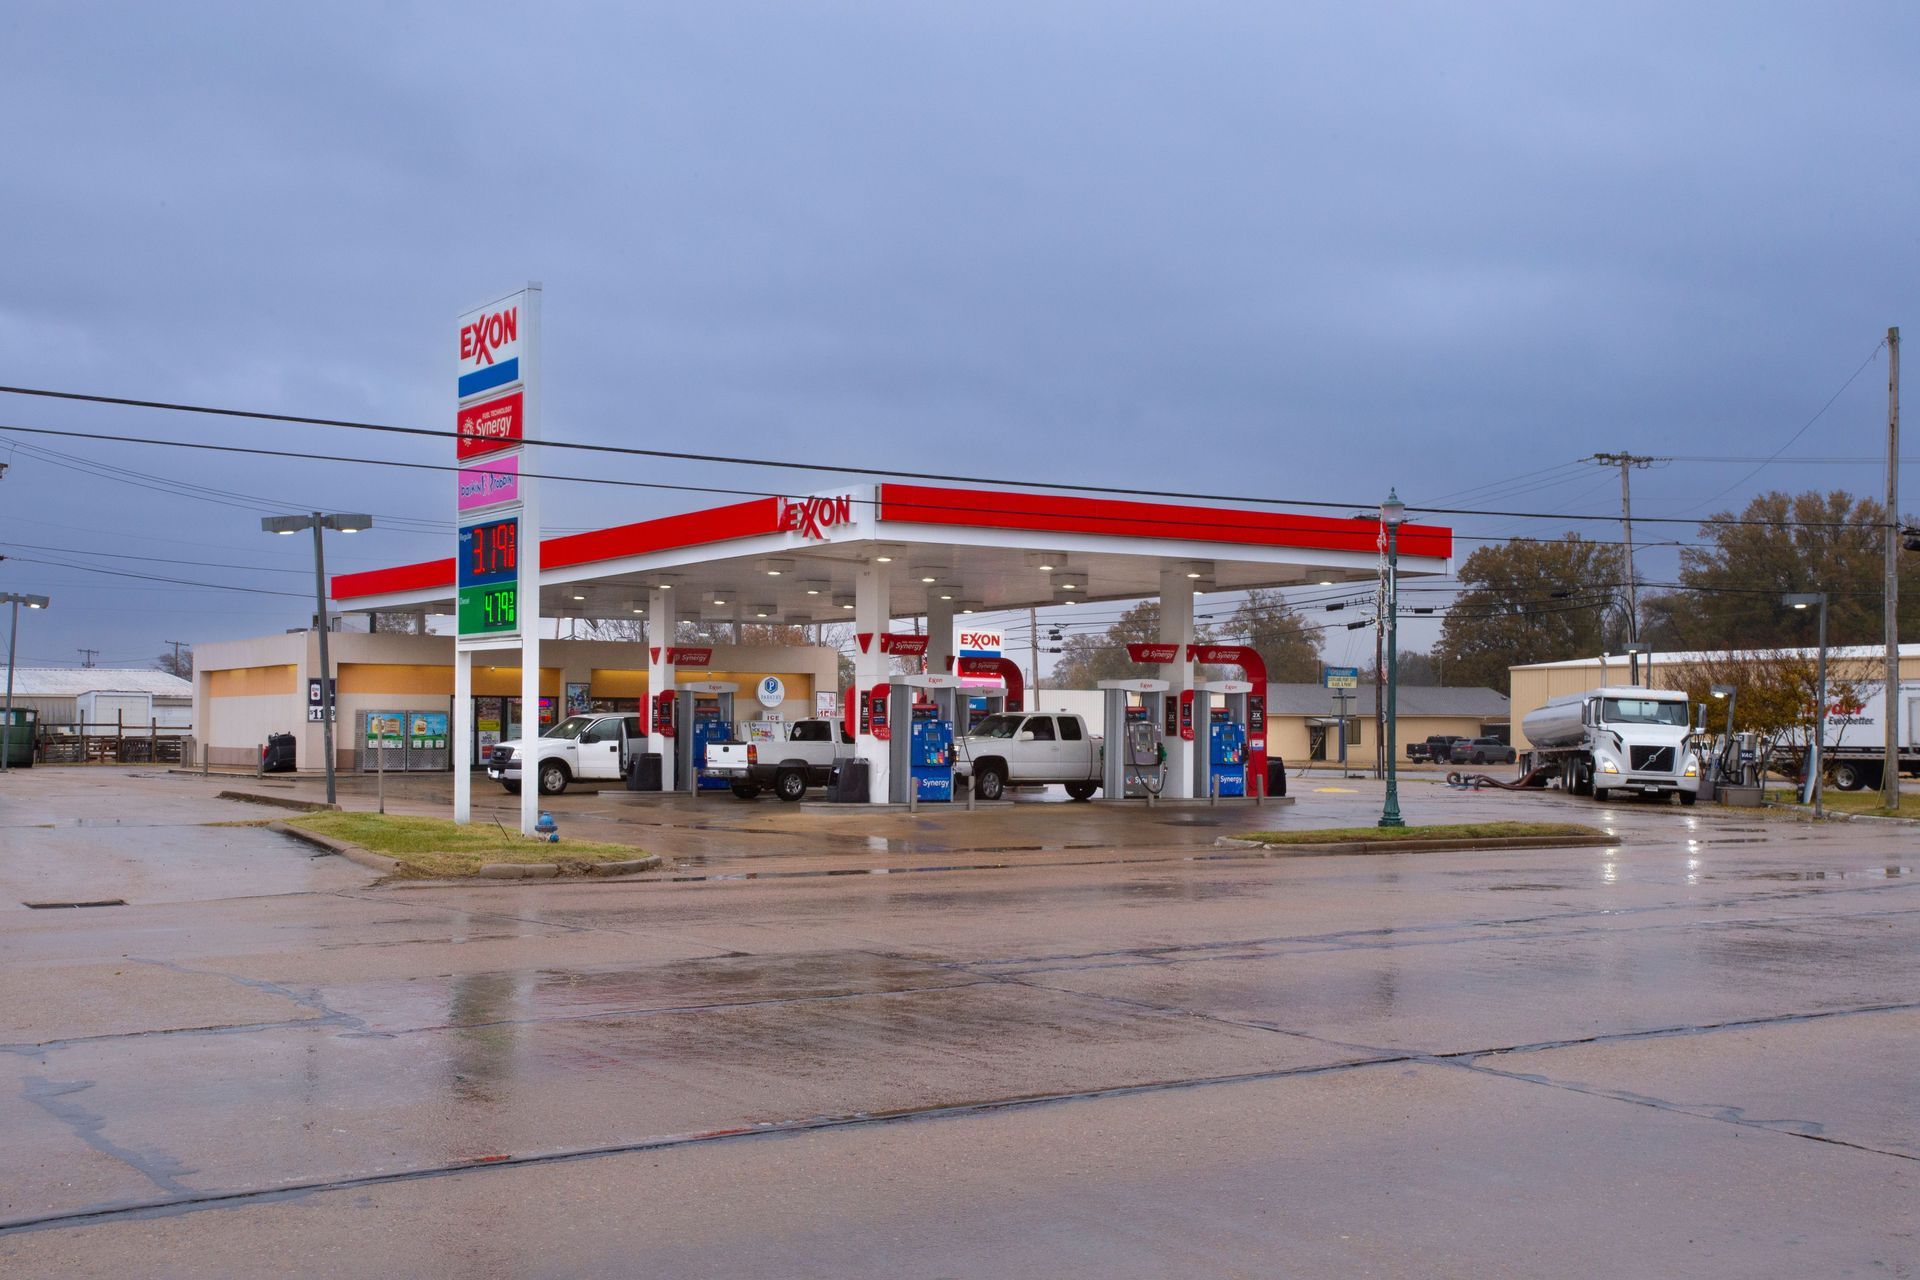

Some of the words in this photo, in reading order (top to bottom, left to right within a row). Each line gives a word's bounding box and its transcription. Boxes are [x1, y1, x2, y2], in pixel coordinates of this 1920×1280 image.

[460, 306, 517, 365] EXXON
[476, 415, 512, 442] Synergy
[784, 495, 851, 540] EXXON
[895, 640, 924, 651] Synergy
[960, 633, 1000, 650] EXXON
[1150, 650, 1174, 659] Synergy
[1216, 651, 1240, 660] Synergy
[923, 778, 950, 788] Synergy
[1220, 775, 1243, 785] Synergy
